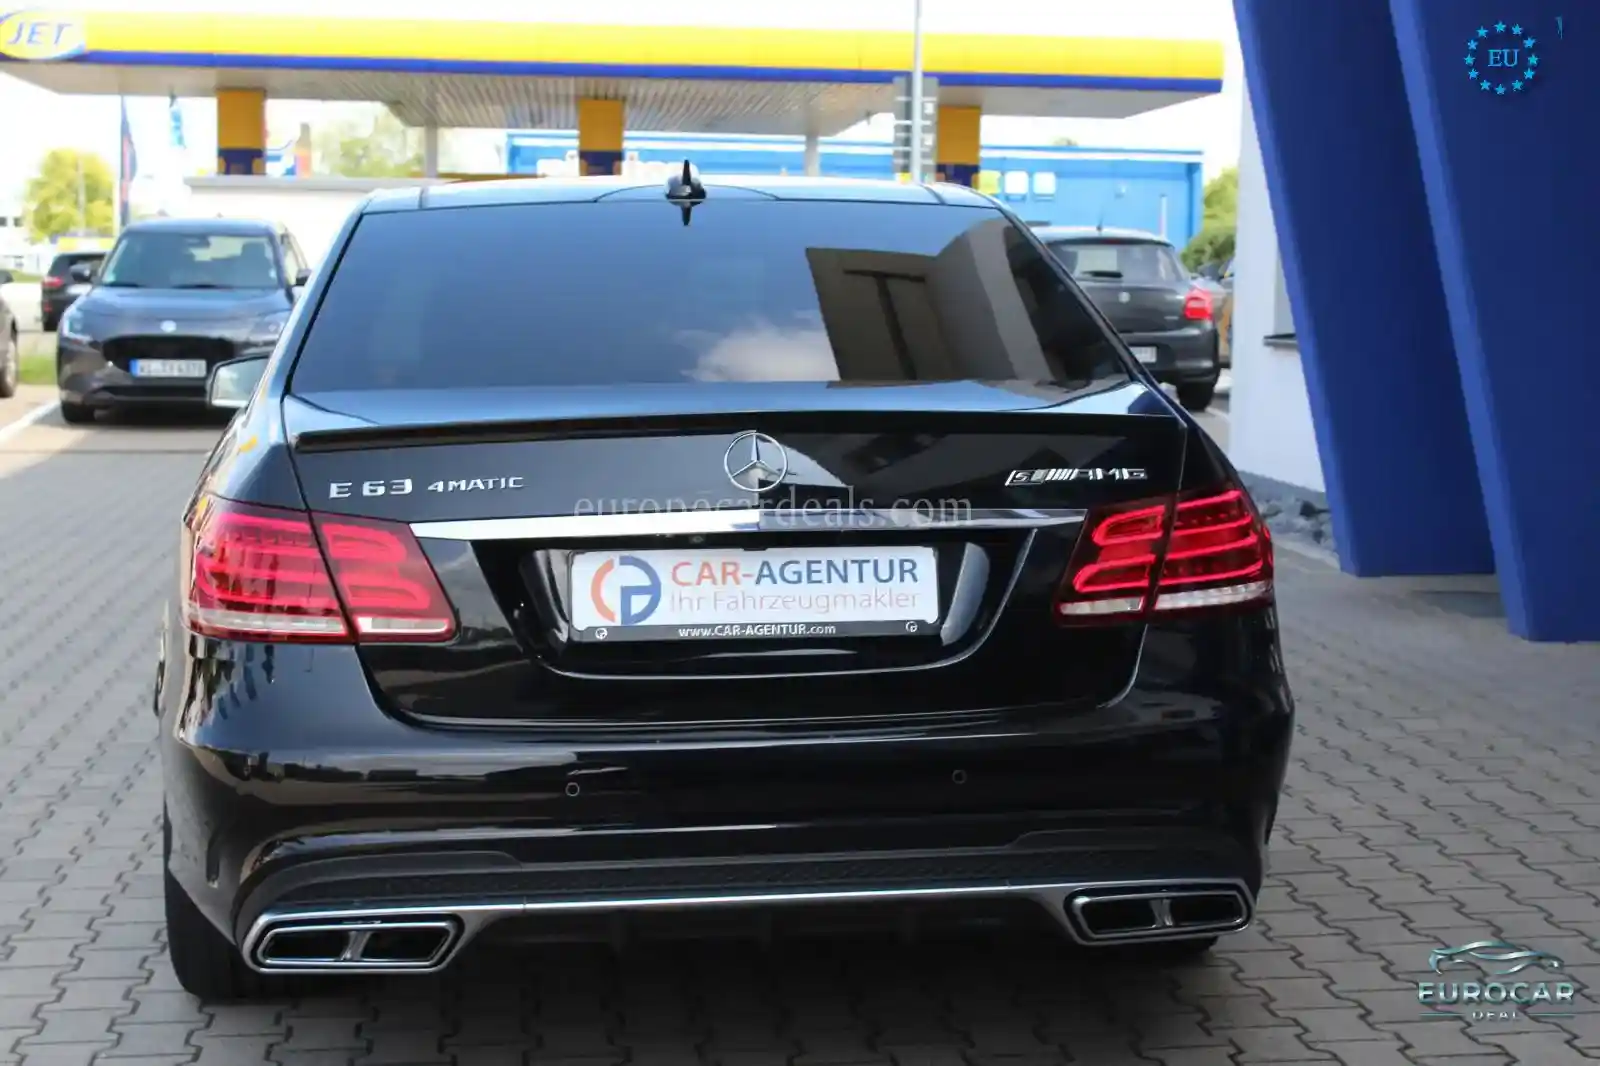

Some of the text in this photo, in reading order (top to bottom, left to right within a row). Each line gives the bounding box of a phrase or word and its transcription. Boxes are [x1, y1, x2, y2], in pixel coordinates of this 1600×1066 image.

[6, 22, 73, 45] JET
[1070, 468, 1148, 481] AMG
[329, 476, 524, 498] E 63 4MATIC
[671, 558, 919, 587] CAR-AGENTUR
[671, 587, 920, 614] Ihr Fahrzeugmakler
[678, 624, 837, 637] www.CAR-AGENTUR.com
